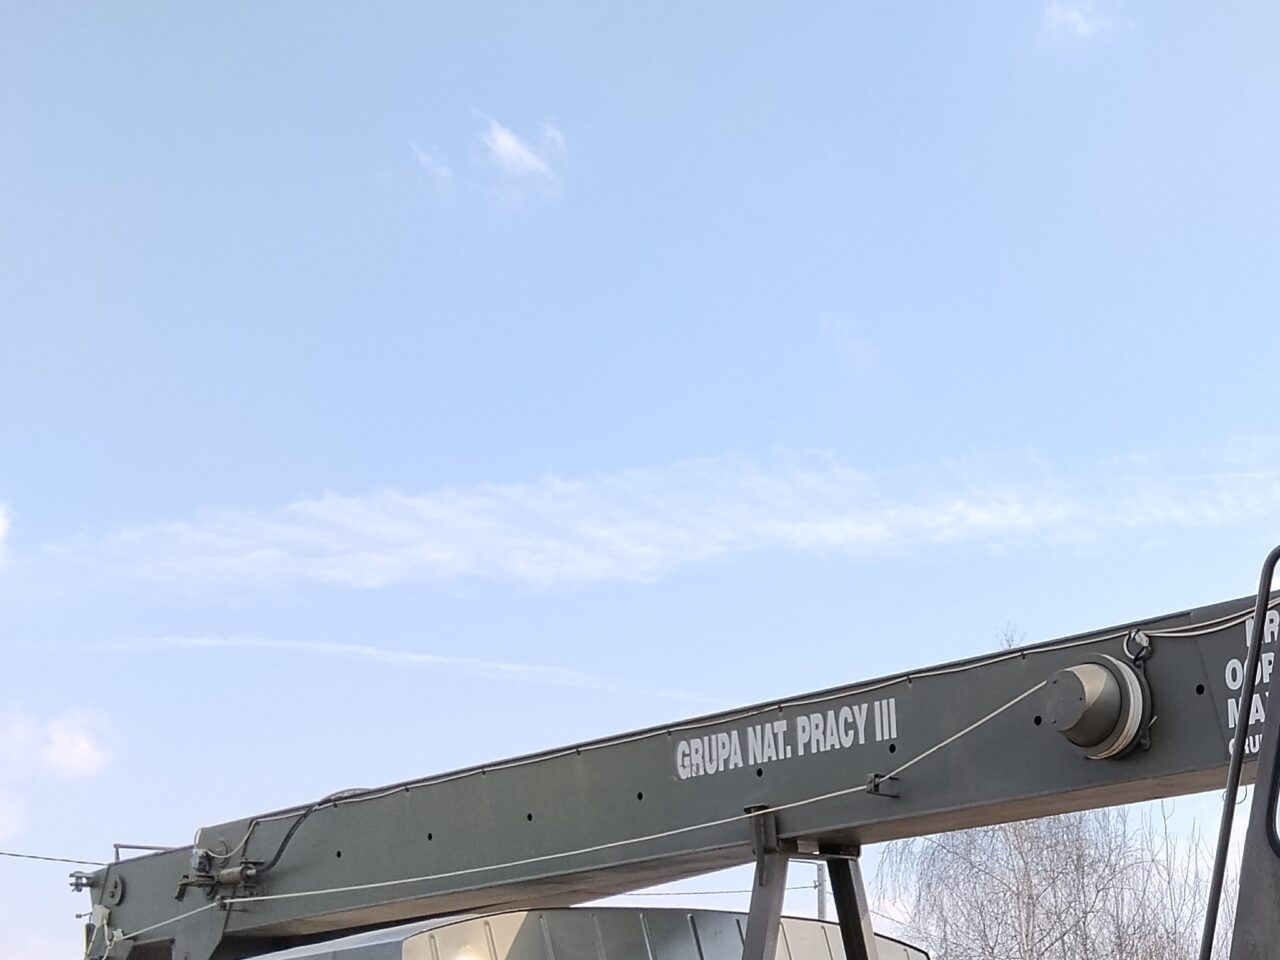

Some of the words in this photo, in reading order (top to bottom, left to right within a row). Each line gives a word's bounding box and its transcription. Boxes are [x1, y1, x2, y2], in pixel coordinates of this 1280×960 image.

[1227, 691, 1270, 729] MA
[676, 730, 744, 780] GRUPA
[747, 720, 792, 766] NAT.
[796, 703, 869, 756] PRACY
